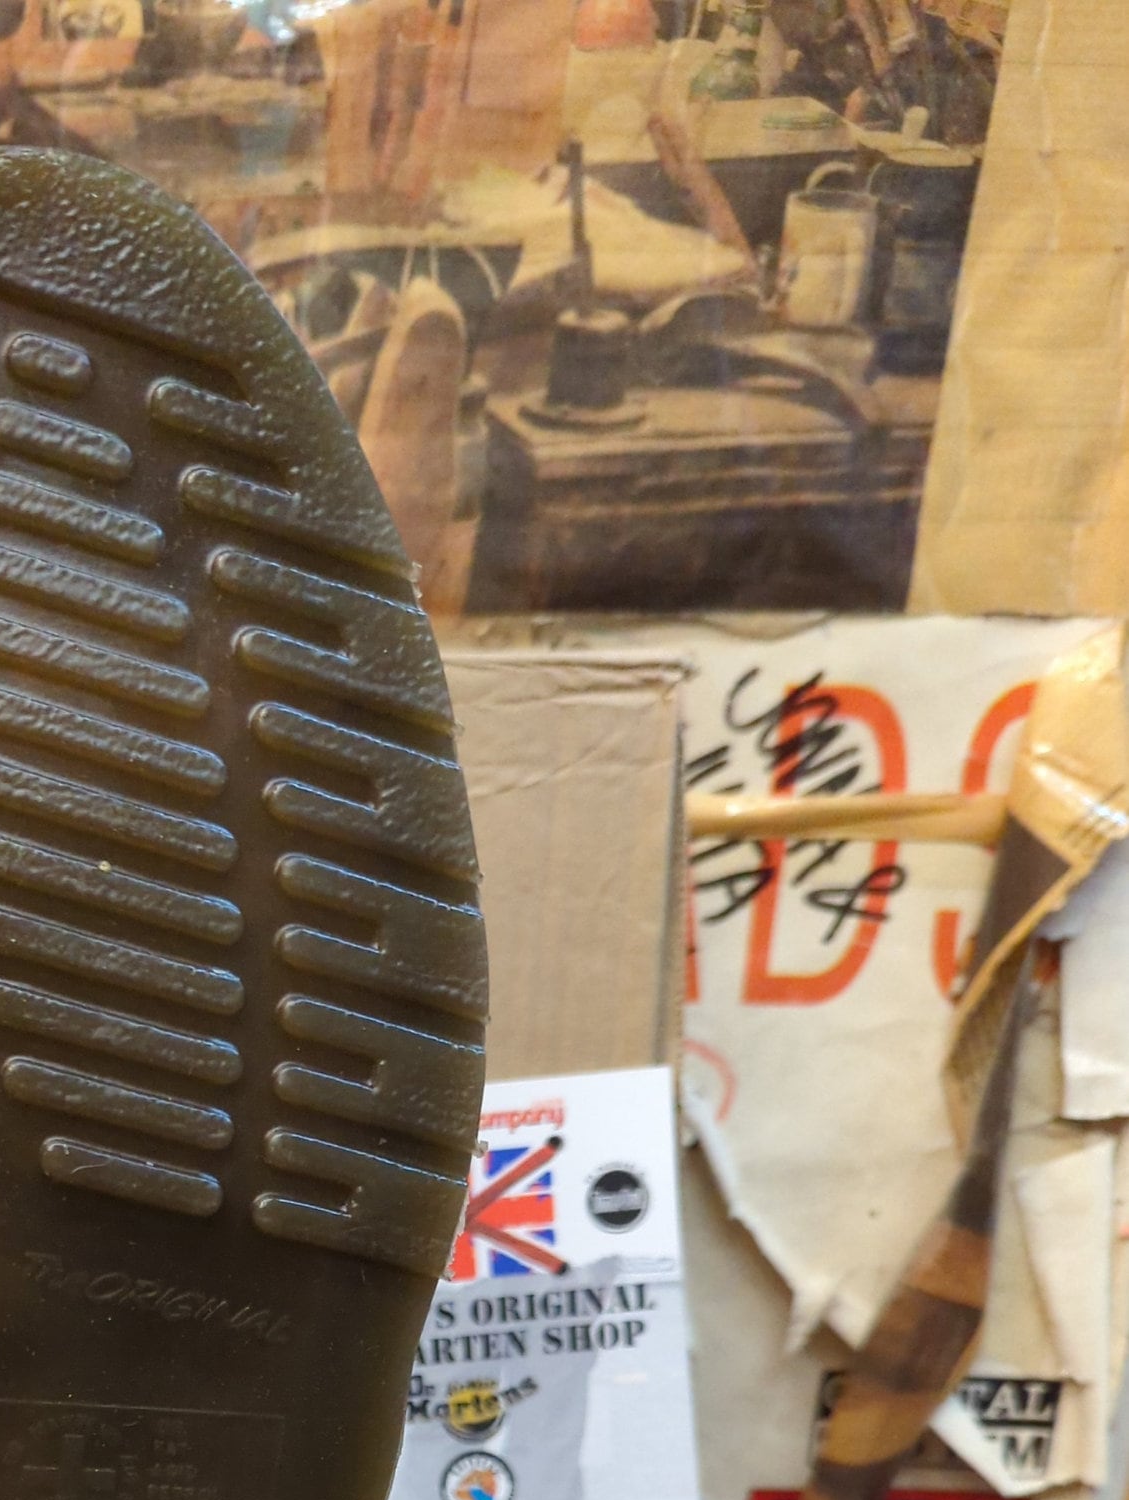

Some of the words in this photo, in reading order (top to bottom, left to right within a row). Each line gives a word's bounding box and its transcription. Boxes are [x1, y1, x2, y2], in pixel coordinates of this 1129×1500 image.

[480, 1104, 564, 1132] ompany
[470, 1284, 657, 1325] ORIGINAL
[414, 1330, 531, 1365] ARTEN
[542, 1320, 647, 1356] SHOP
[954, 1381, 1054, 1422] TAL
